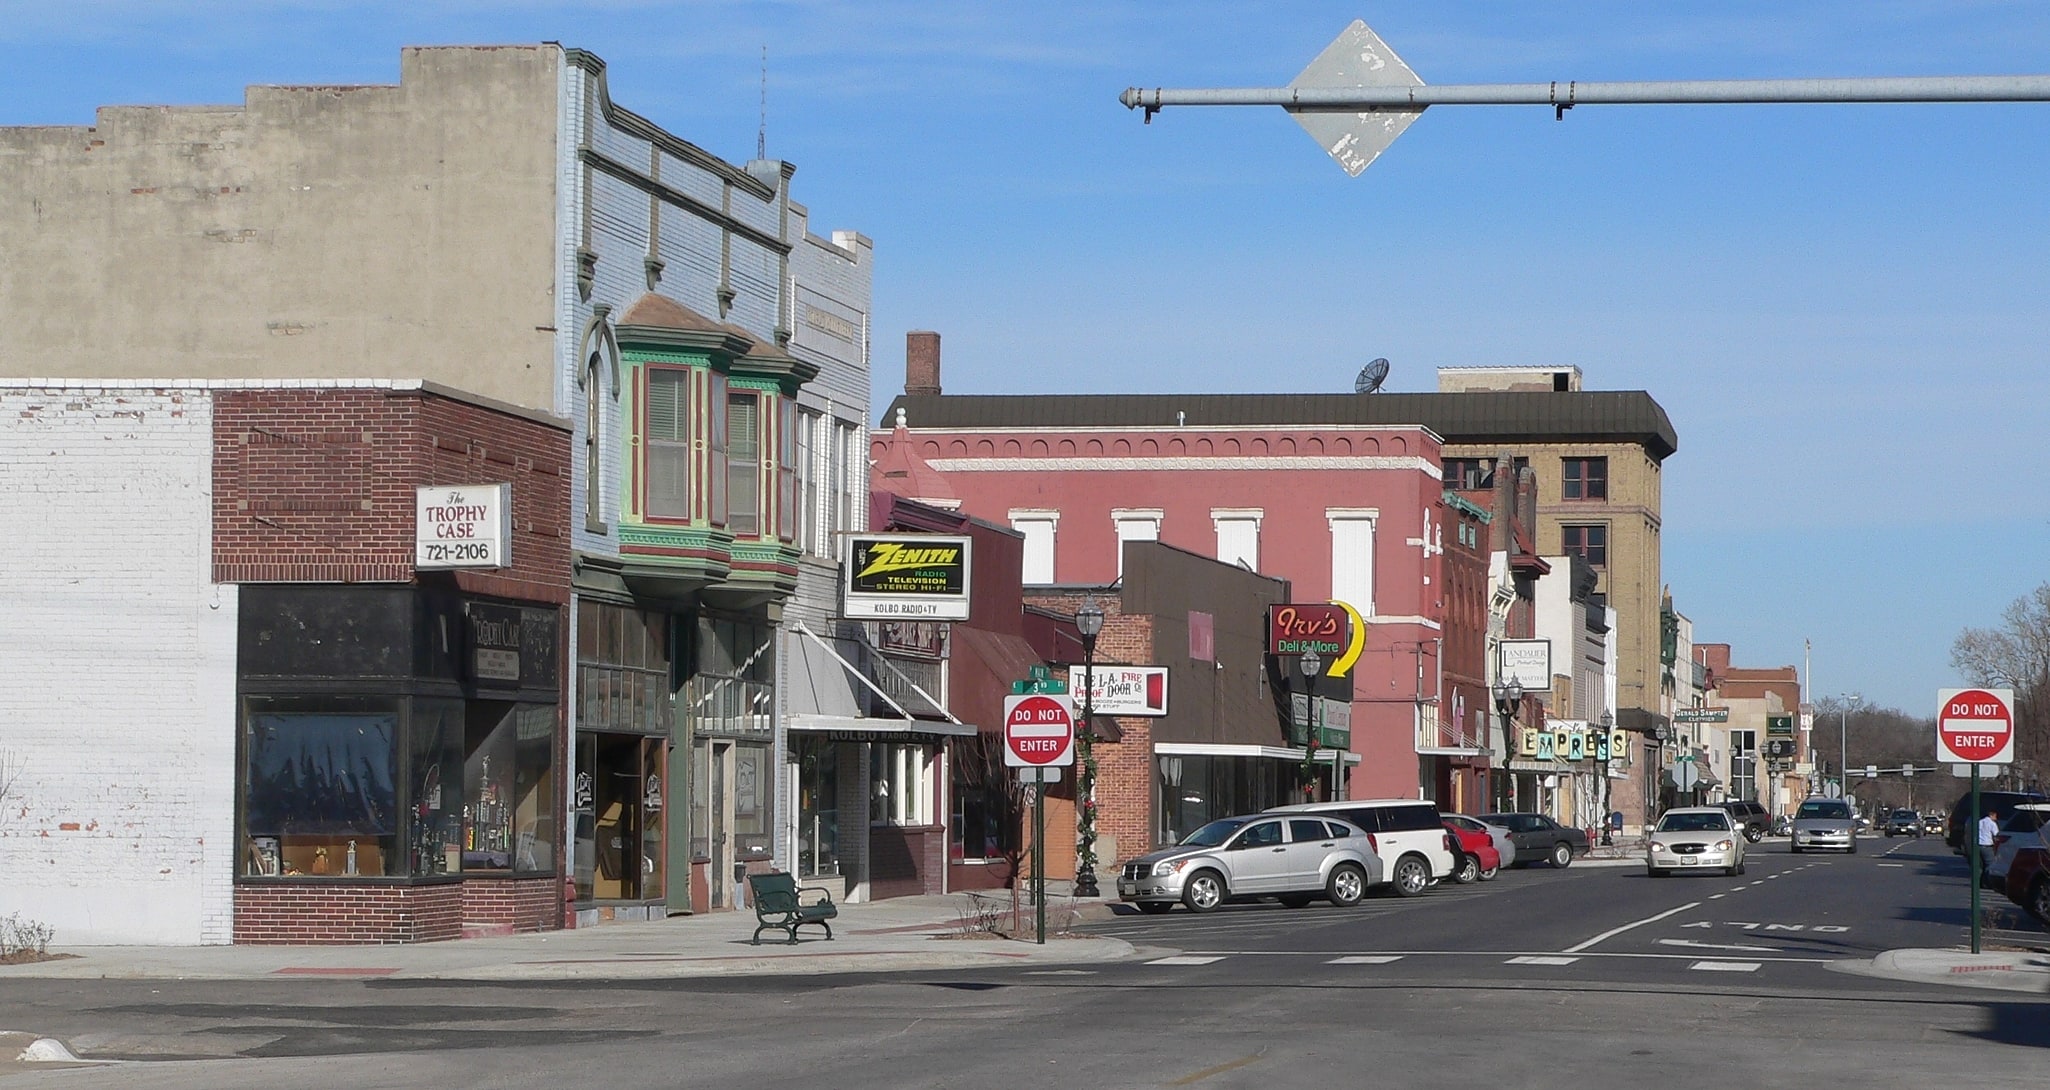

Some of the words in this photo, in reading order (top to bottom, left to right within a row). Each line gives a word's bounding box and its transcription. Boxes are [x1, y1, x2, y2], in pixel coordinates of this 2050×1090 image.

[447, 491, 465, 504] The
[426, 505, 487, 522] TROPHY
[436, 523, 475, 538] CASE
[426, 544, 489, 560] 721-2106
[856, 543, 960, 578] ZENITH
[876, 583, 917, 591] STEREO
[888, 577, 947, 585] TELEVISION
[874, 603, 899, 613] KOLBO
[1277, 607, 1338, 636] Irv's
[1278, 640, 1299, 652] Deli
[1311, 642, 1339, 653] More
[1074, 672, 1096, 687] TE
[1121, 672, 1142, 683] FIRE
[1074, 685, 1104, 698] PROF
[1107, 683, 1131, 698] DOOR
[1015, 709, 1031, 721] DO
[1038, 709, 1062, 721] NOT
[1675, 708, 1698, 717] GERALD
[1952, 703, 1969, 716] DO
[1974, 703, 1999, 716] NOT
[829, 730, 877, 741] KOLBO
[1955, 735, 1996, 748] ENTER
[1020, 740, 1058, 752] ENTER
[1525, 732, 1624, 756] EMPRESS
